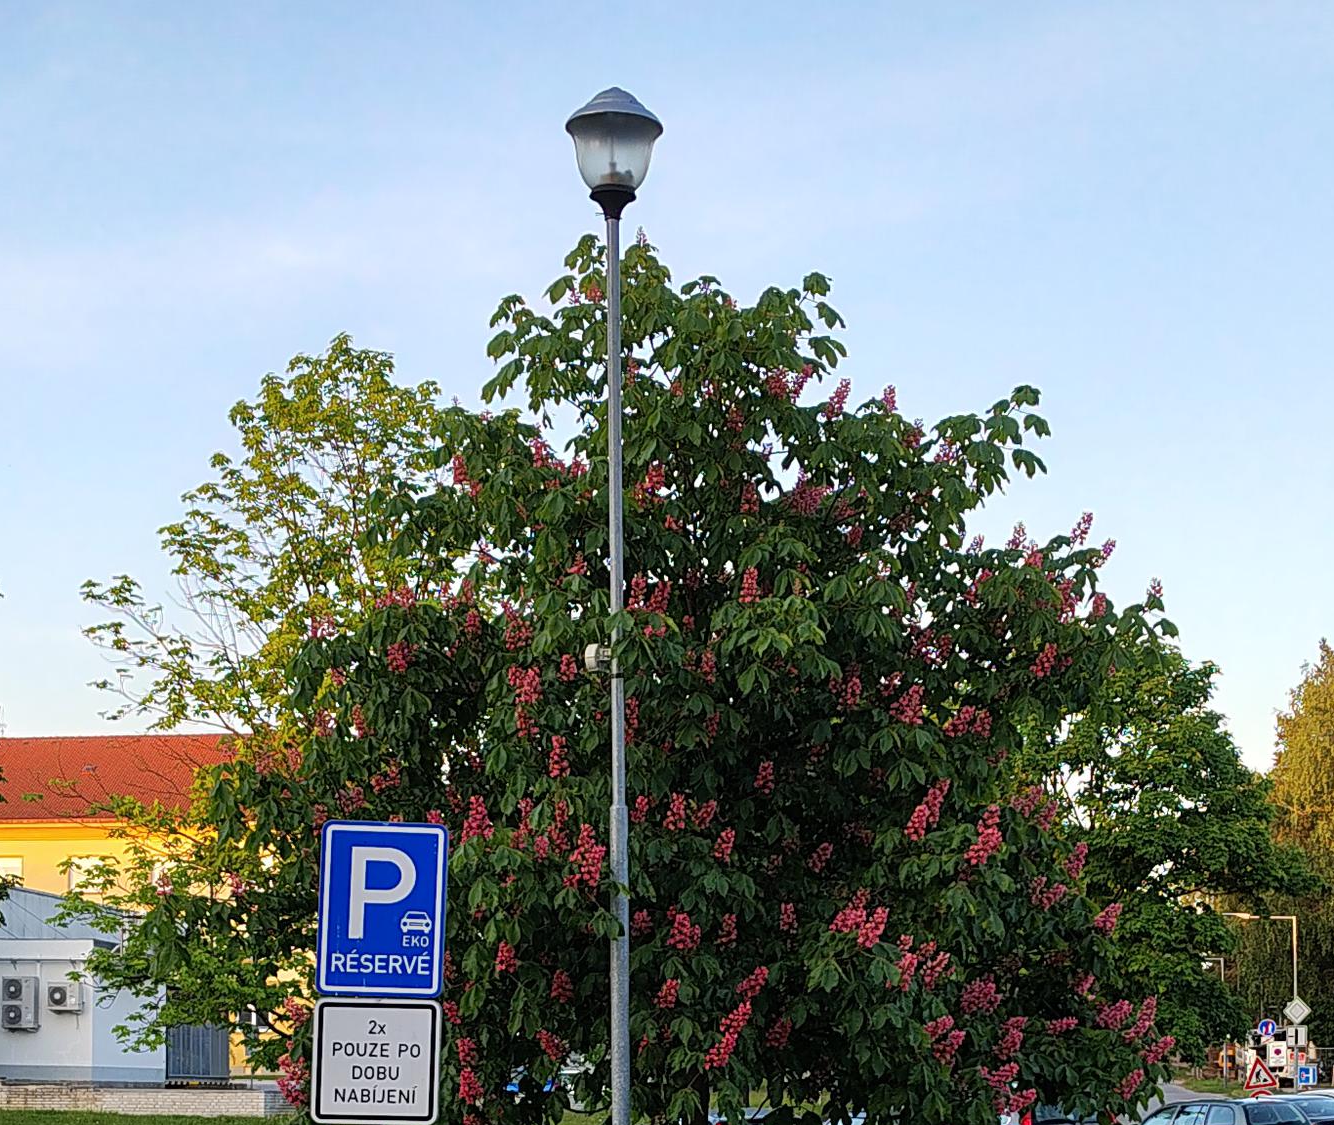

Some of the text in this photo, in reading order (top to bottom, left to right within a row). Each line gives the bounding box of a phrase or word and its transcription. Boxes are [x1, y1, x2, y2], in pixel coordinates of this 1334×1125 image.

[348, 846, 417, 939] P
[402, 936, 429, 948] EKO
[330, 949, 430, 976] RÉSERVÉ
[368, 1020, 386, 1035] 2x
[332, 1042, 421, 1058] POUZE PO
[351, 1065, 400, 1081] DOBU
[334, 1085, 417, 1105] NABÍJENÍ
